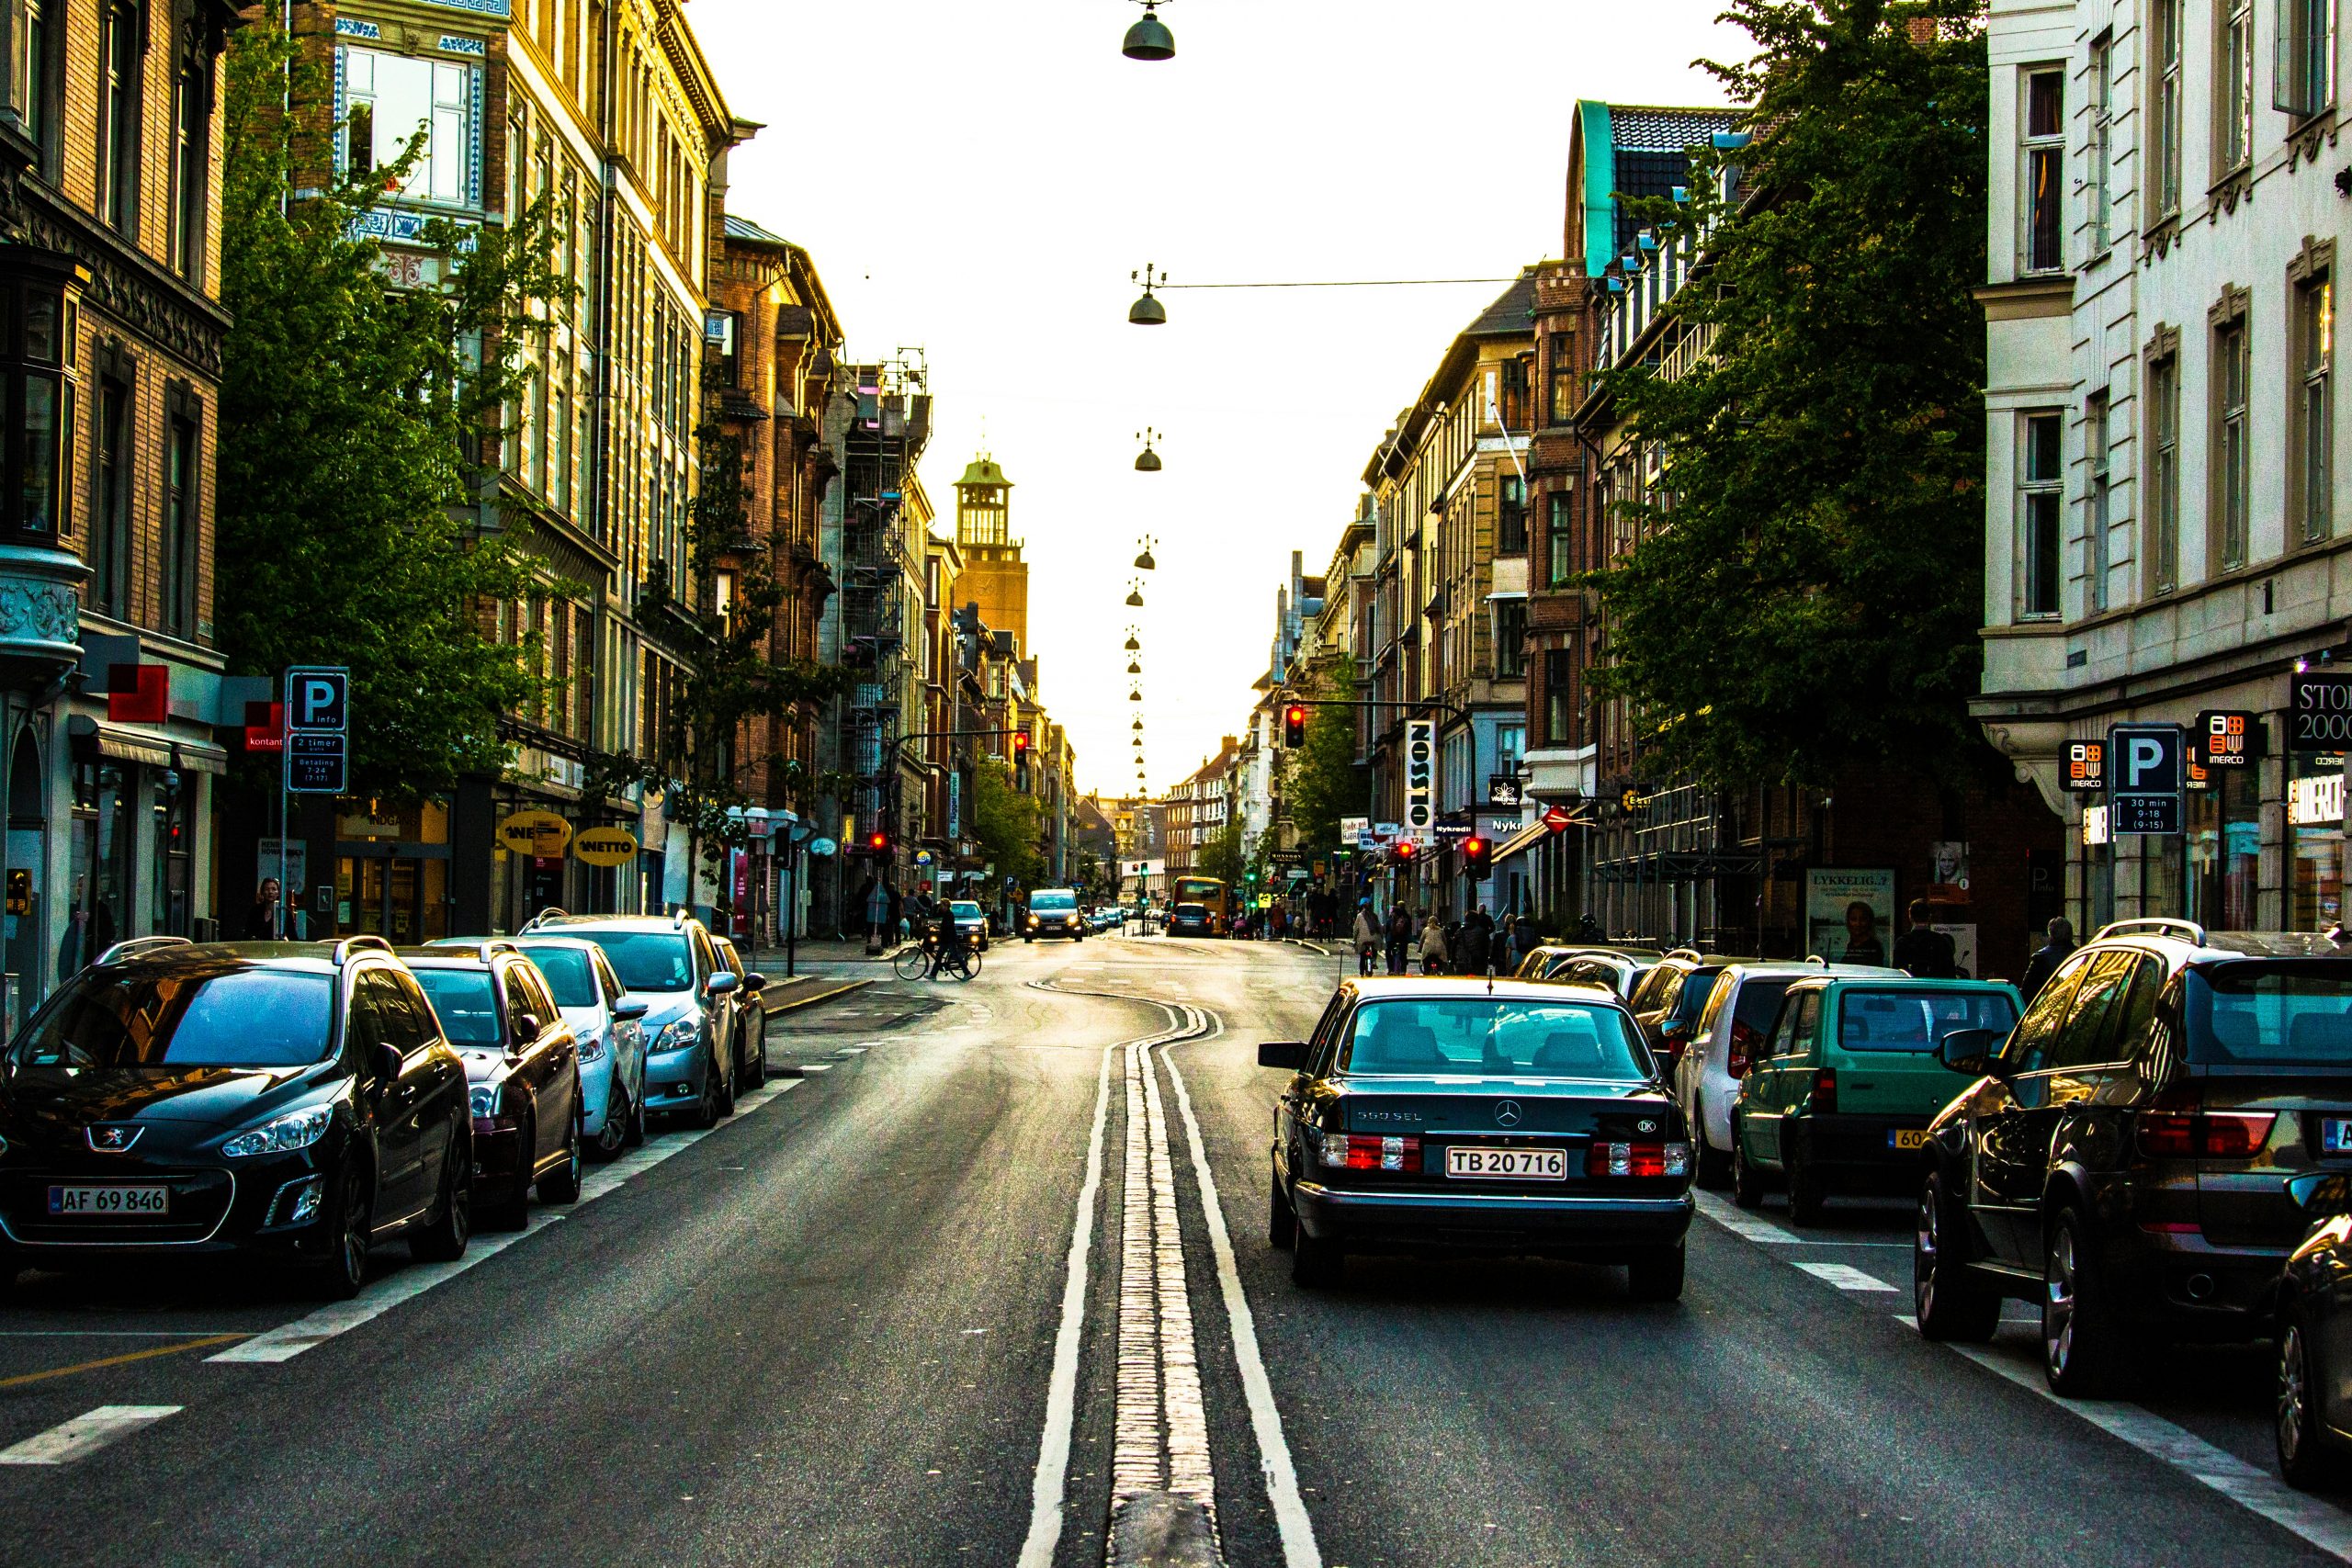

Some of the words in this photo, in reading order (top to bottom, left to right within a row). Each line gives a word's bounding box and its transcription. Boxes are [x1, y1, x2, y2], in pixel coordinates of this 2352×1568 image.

[304, 681, 334, 722] P
[250, 738, 283, 746] kontant
[298, 739, 304, 747] 2
[309, 739, 335, 747] timer
[300, 759, 334, 767] Betaling
[2129, 738, 2164, 786] P
[2209, 756, 2244, 764] IMERCO
[1410, 725, 1430, 826] OLSSON
[2131, 799, 2144, 807] 30
[2149, 799, 2166, 807] min
[2137, 809, 2160, 818] 9-18
[2133, 820, 2164, 829] (9-15)
[1410, 837, 1425, 845] 124
[586, 841, 632, 853] NETTO
[1007, 876, 1013, 886] P
[1393, 1112, 1422, 1121] SEL
[1641, 1122, 1652, 1131] DK
[1901, 1132, 1921, 1146] 60
[1452, 1152, 1484, 1171] TB
[1487, 1154, 1516, 1173] 20
[1520, 1154, 1562, 1174] 716
[64, 1190, 90, 1210] AF
[96, 1190, 121, 1211] 69
[126, 1190, 164, 1211] 846
